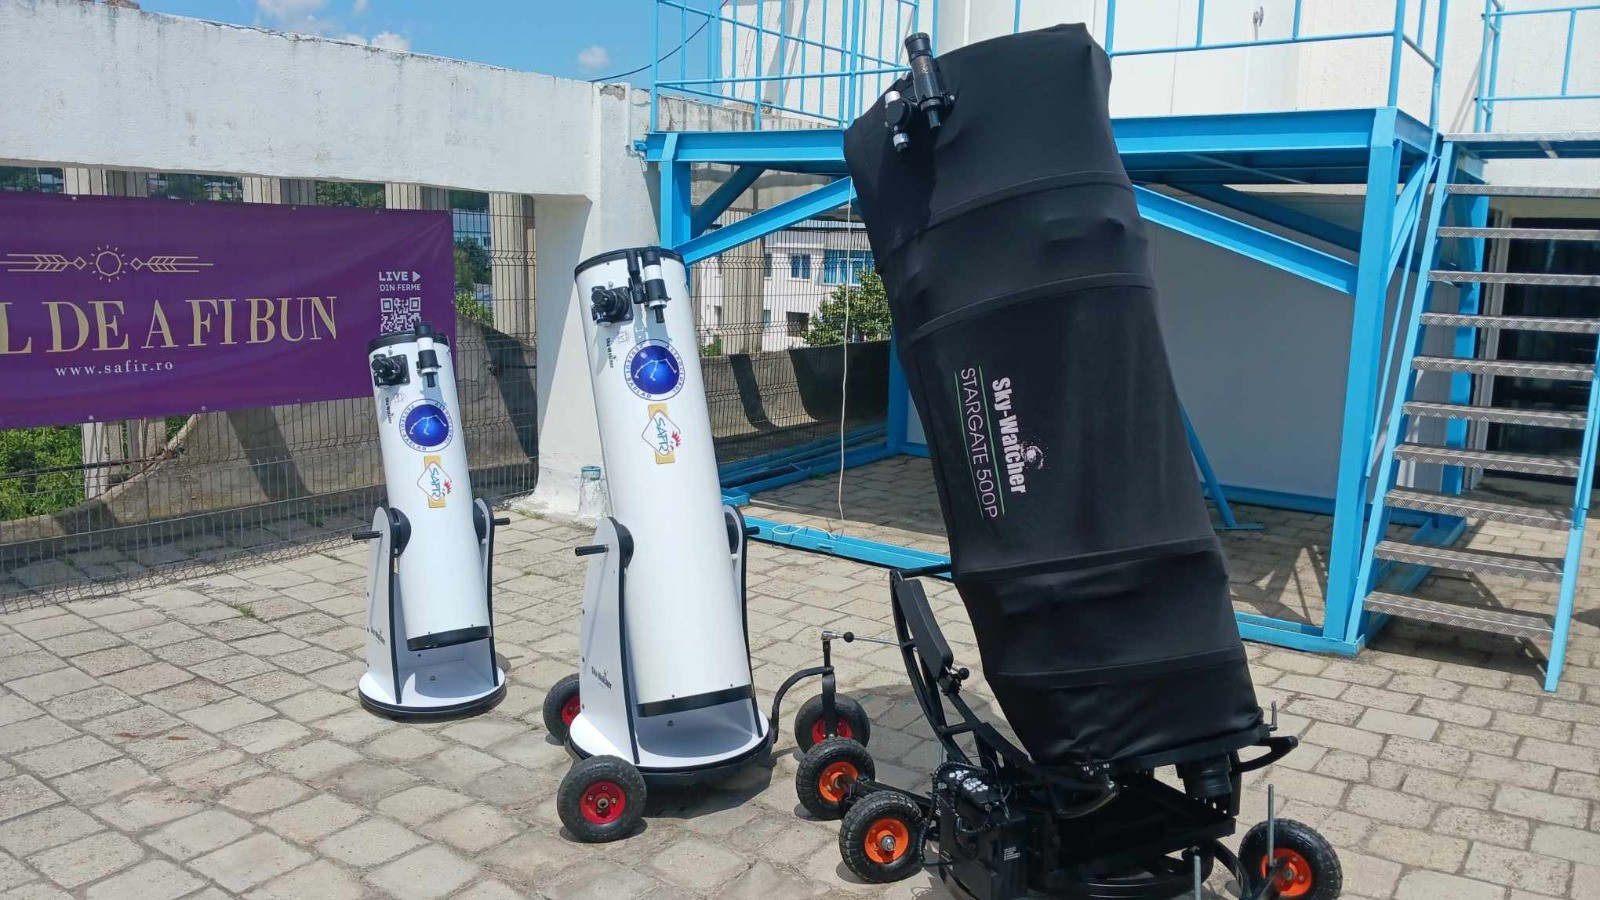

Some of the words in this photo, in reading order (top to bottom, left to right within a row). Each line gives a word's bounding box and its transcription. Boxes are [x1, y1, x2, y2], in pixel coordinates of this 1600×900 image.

[379, 271, 408, 281] LIVE
[42, 301, 129, 353] DE
[141, 299, 179, 349] A
[185, 299, 237, 347] FI
[245, 296, 337, 344] BUN
[55, 360, 173, 376] www.safir.ro
[960, 367, 989, 465] STARGATE
[976, 469, 998, 519] 500P
[992, 377, 1026, 494] Sky-Watcher
